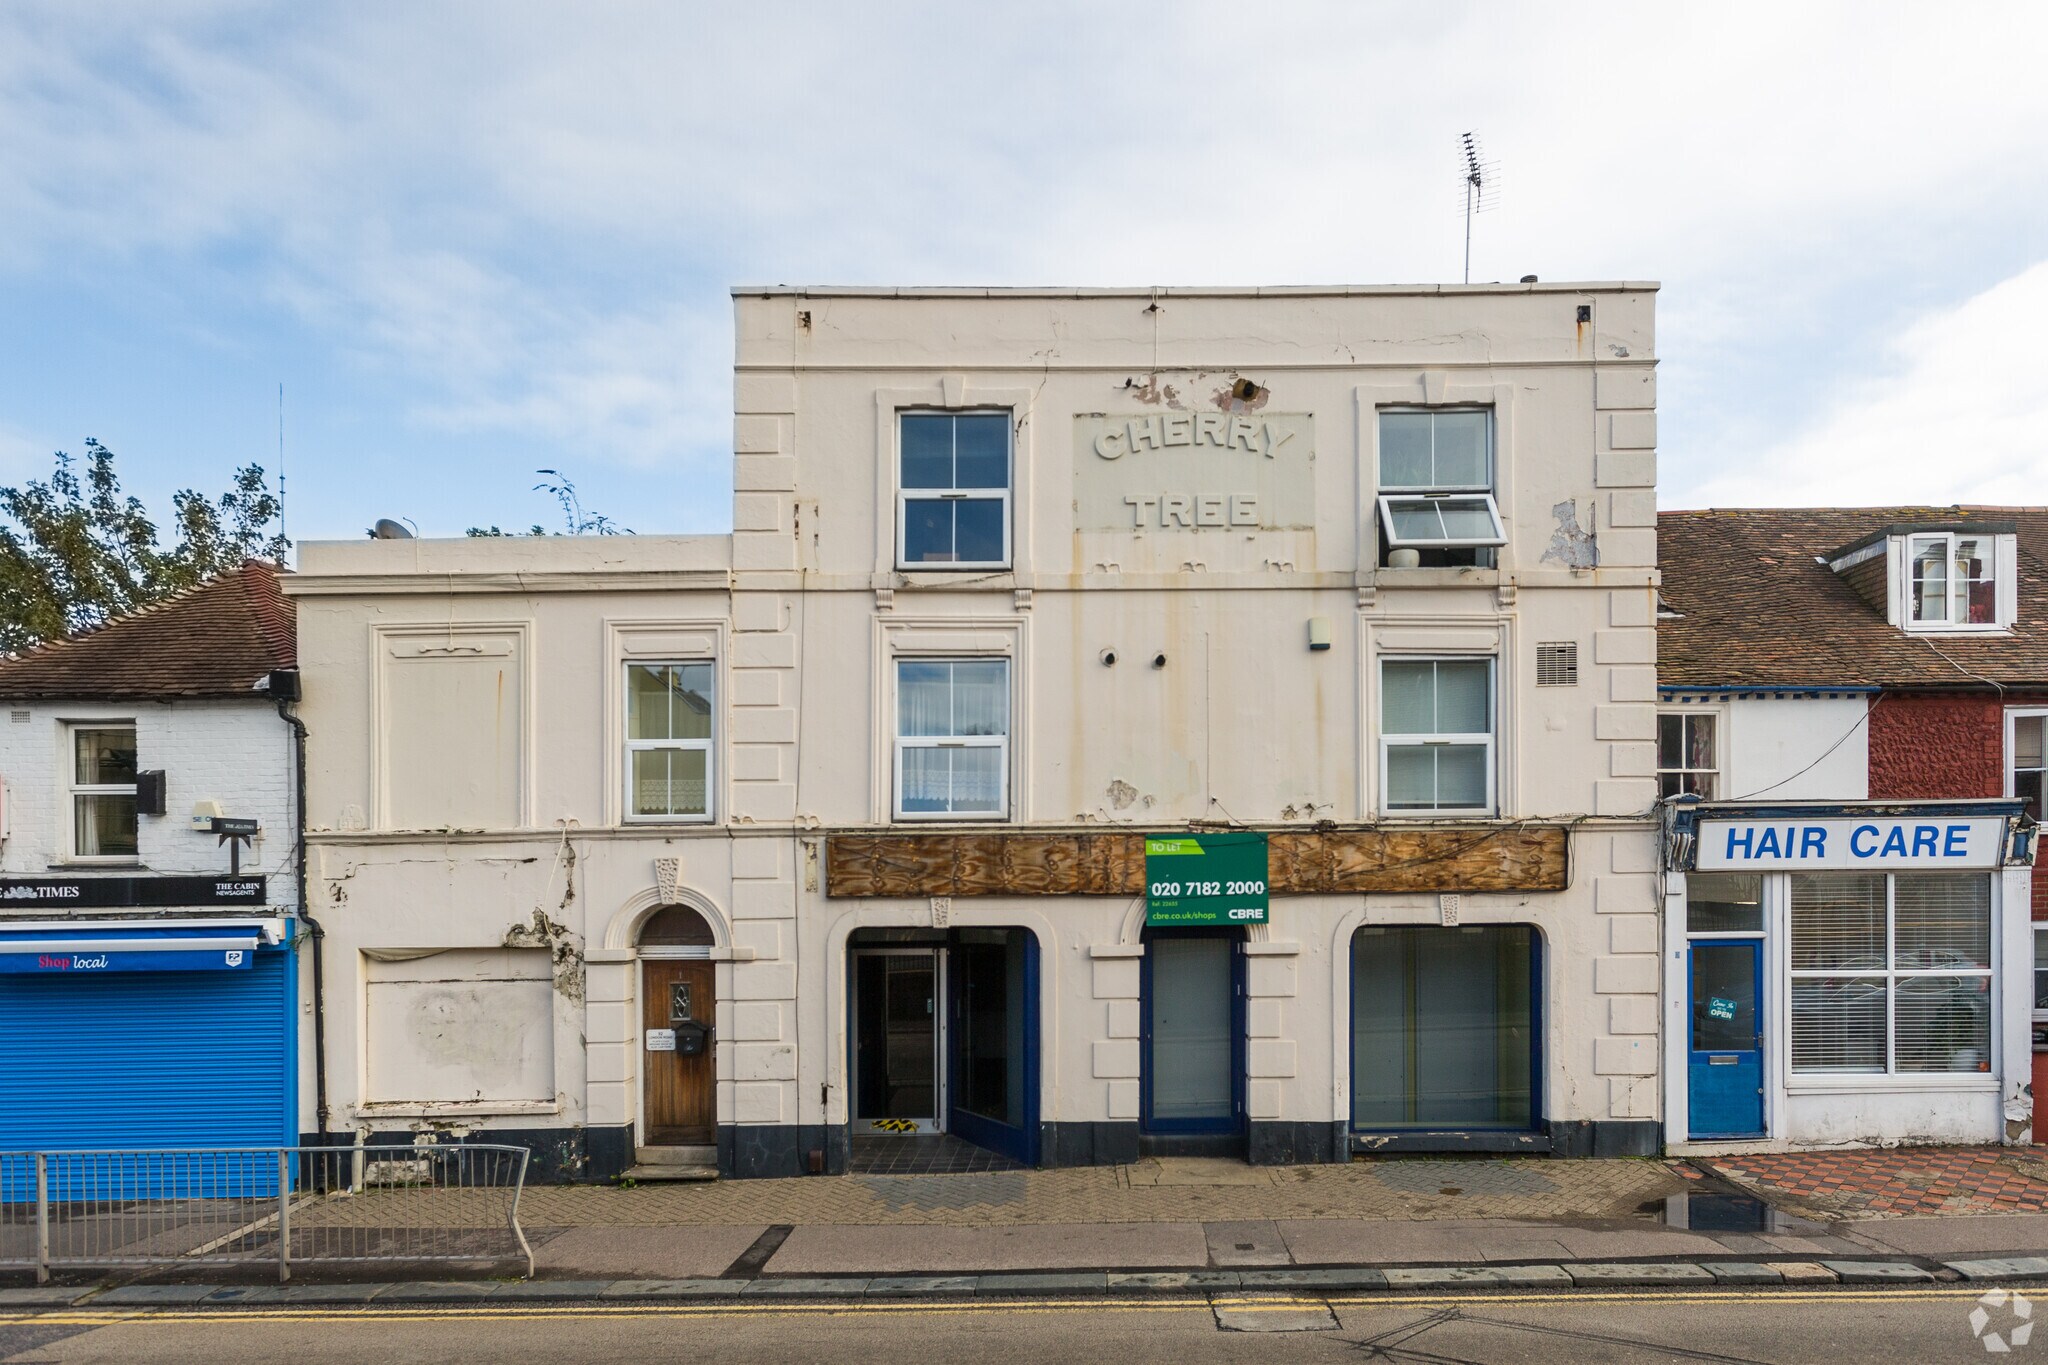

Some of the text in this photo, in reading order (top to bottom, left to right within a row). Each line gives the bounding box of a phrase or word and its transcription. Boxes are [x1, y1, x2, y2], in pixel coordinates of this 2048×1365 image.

[1095, 414, 1295, 461] CHERRY
[1124, 494, 1259, 528] TREE
[1151, 842, 1181, 852] TO LET
[1726, 824, 1971, 860] HAIR CARE
[36, 886, 80, 898] TIMES
[215, 882, 260, 890] THE CABIN
[1152, 880, 1265, 896] 020 7182 2000
[1152, 911, 1217, 920] cbre.co.uk/shops
[1228, 908, 1264, 920] CBRE
[39, 954, 109, 971] Shop local
[1711, 1009, 1732, 1019] OPEN
